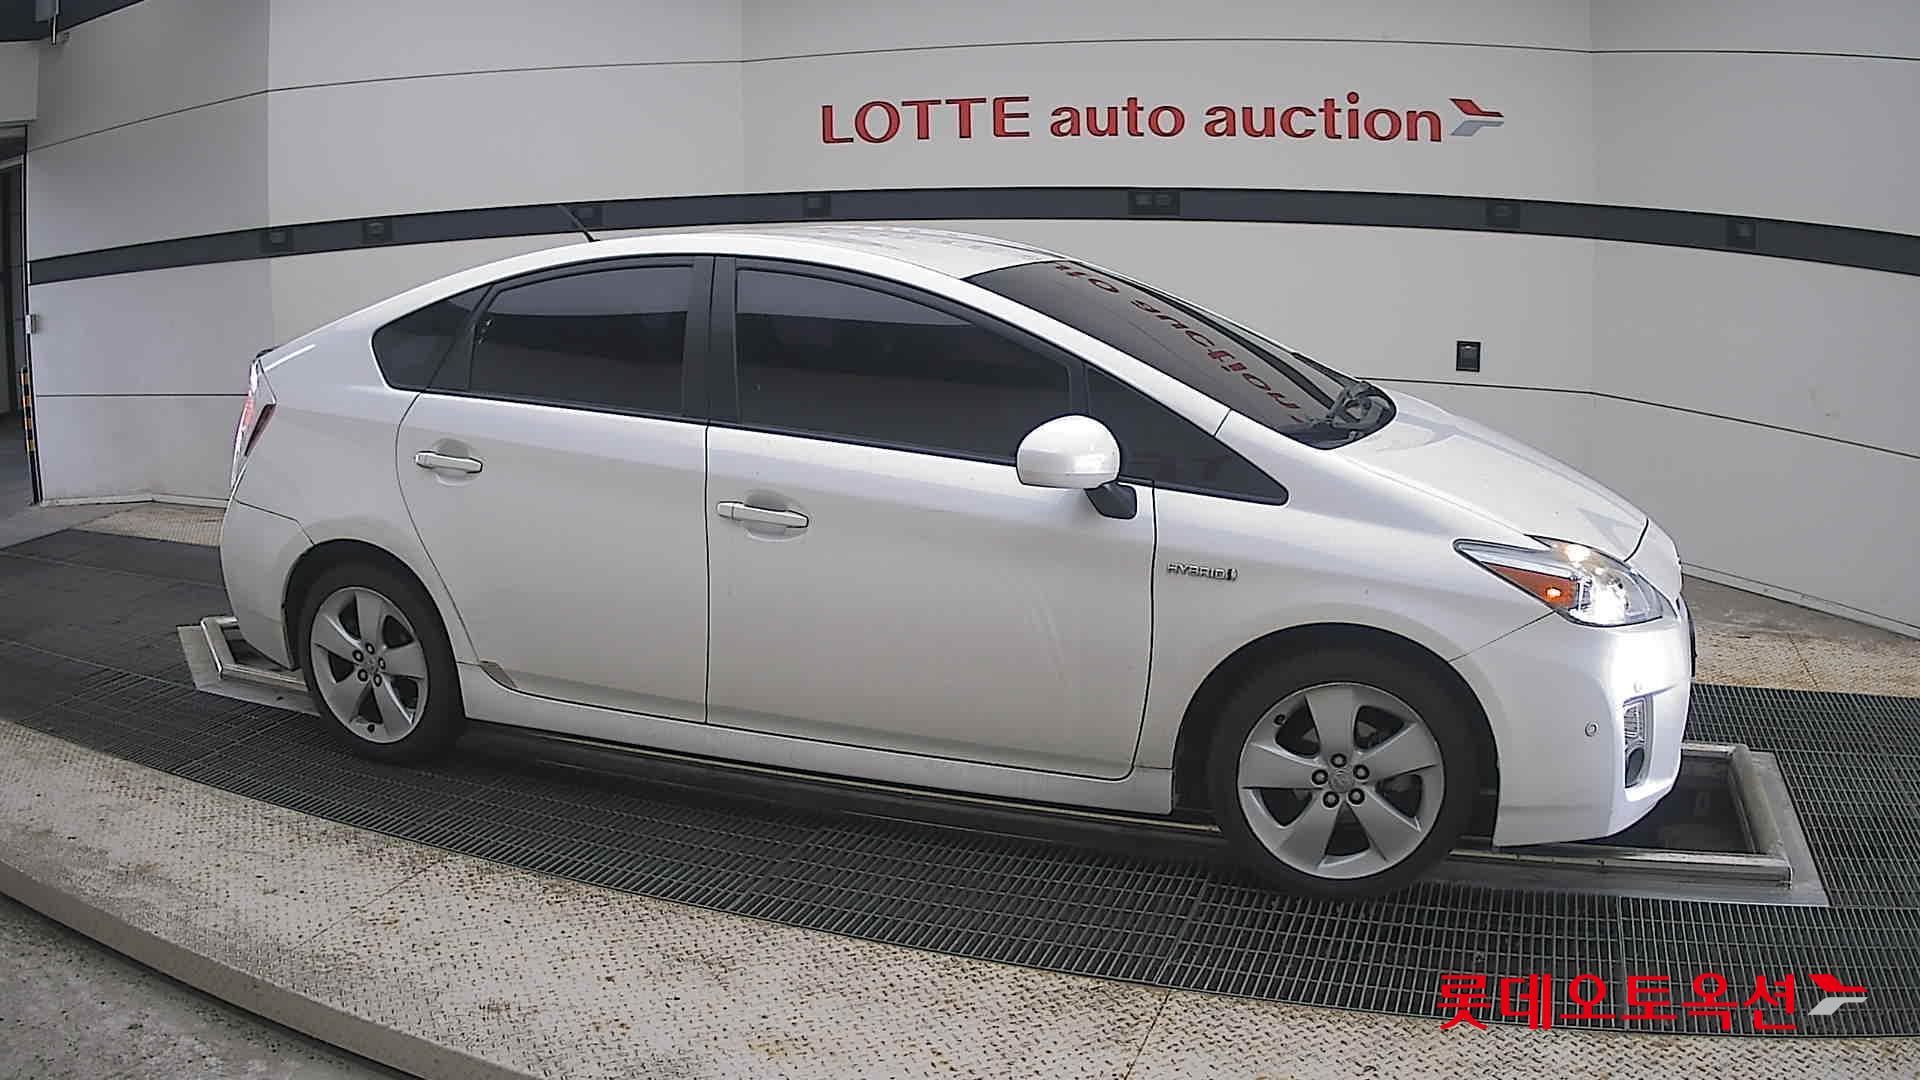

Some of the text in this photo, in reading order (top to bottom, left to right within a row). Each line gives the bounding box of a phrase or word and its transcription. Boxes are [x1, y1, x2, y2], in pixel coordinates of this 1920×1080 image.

[822, 91, 1442, 145] LOTTE auto auction
[1167, 563, 1227, 580] HYBRID
